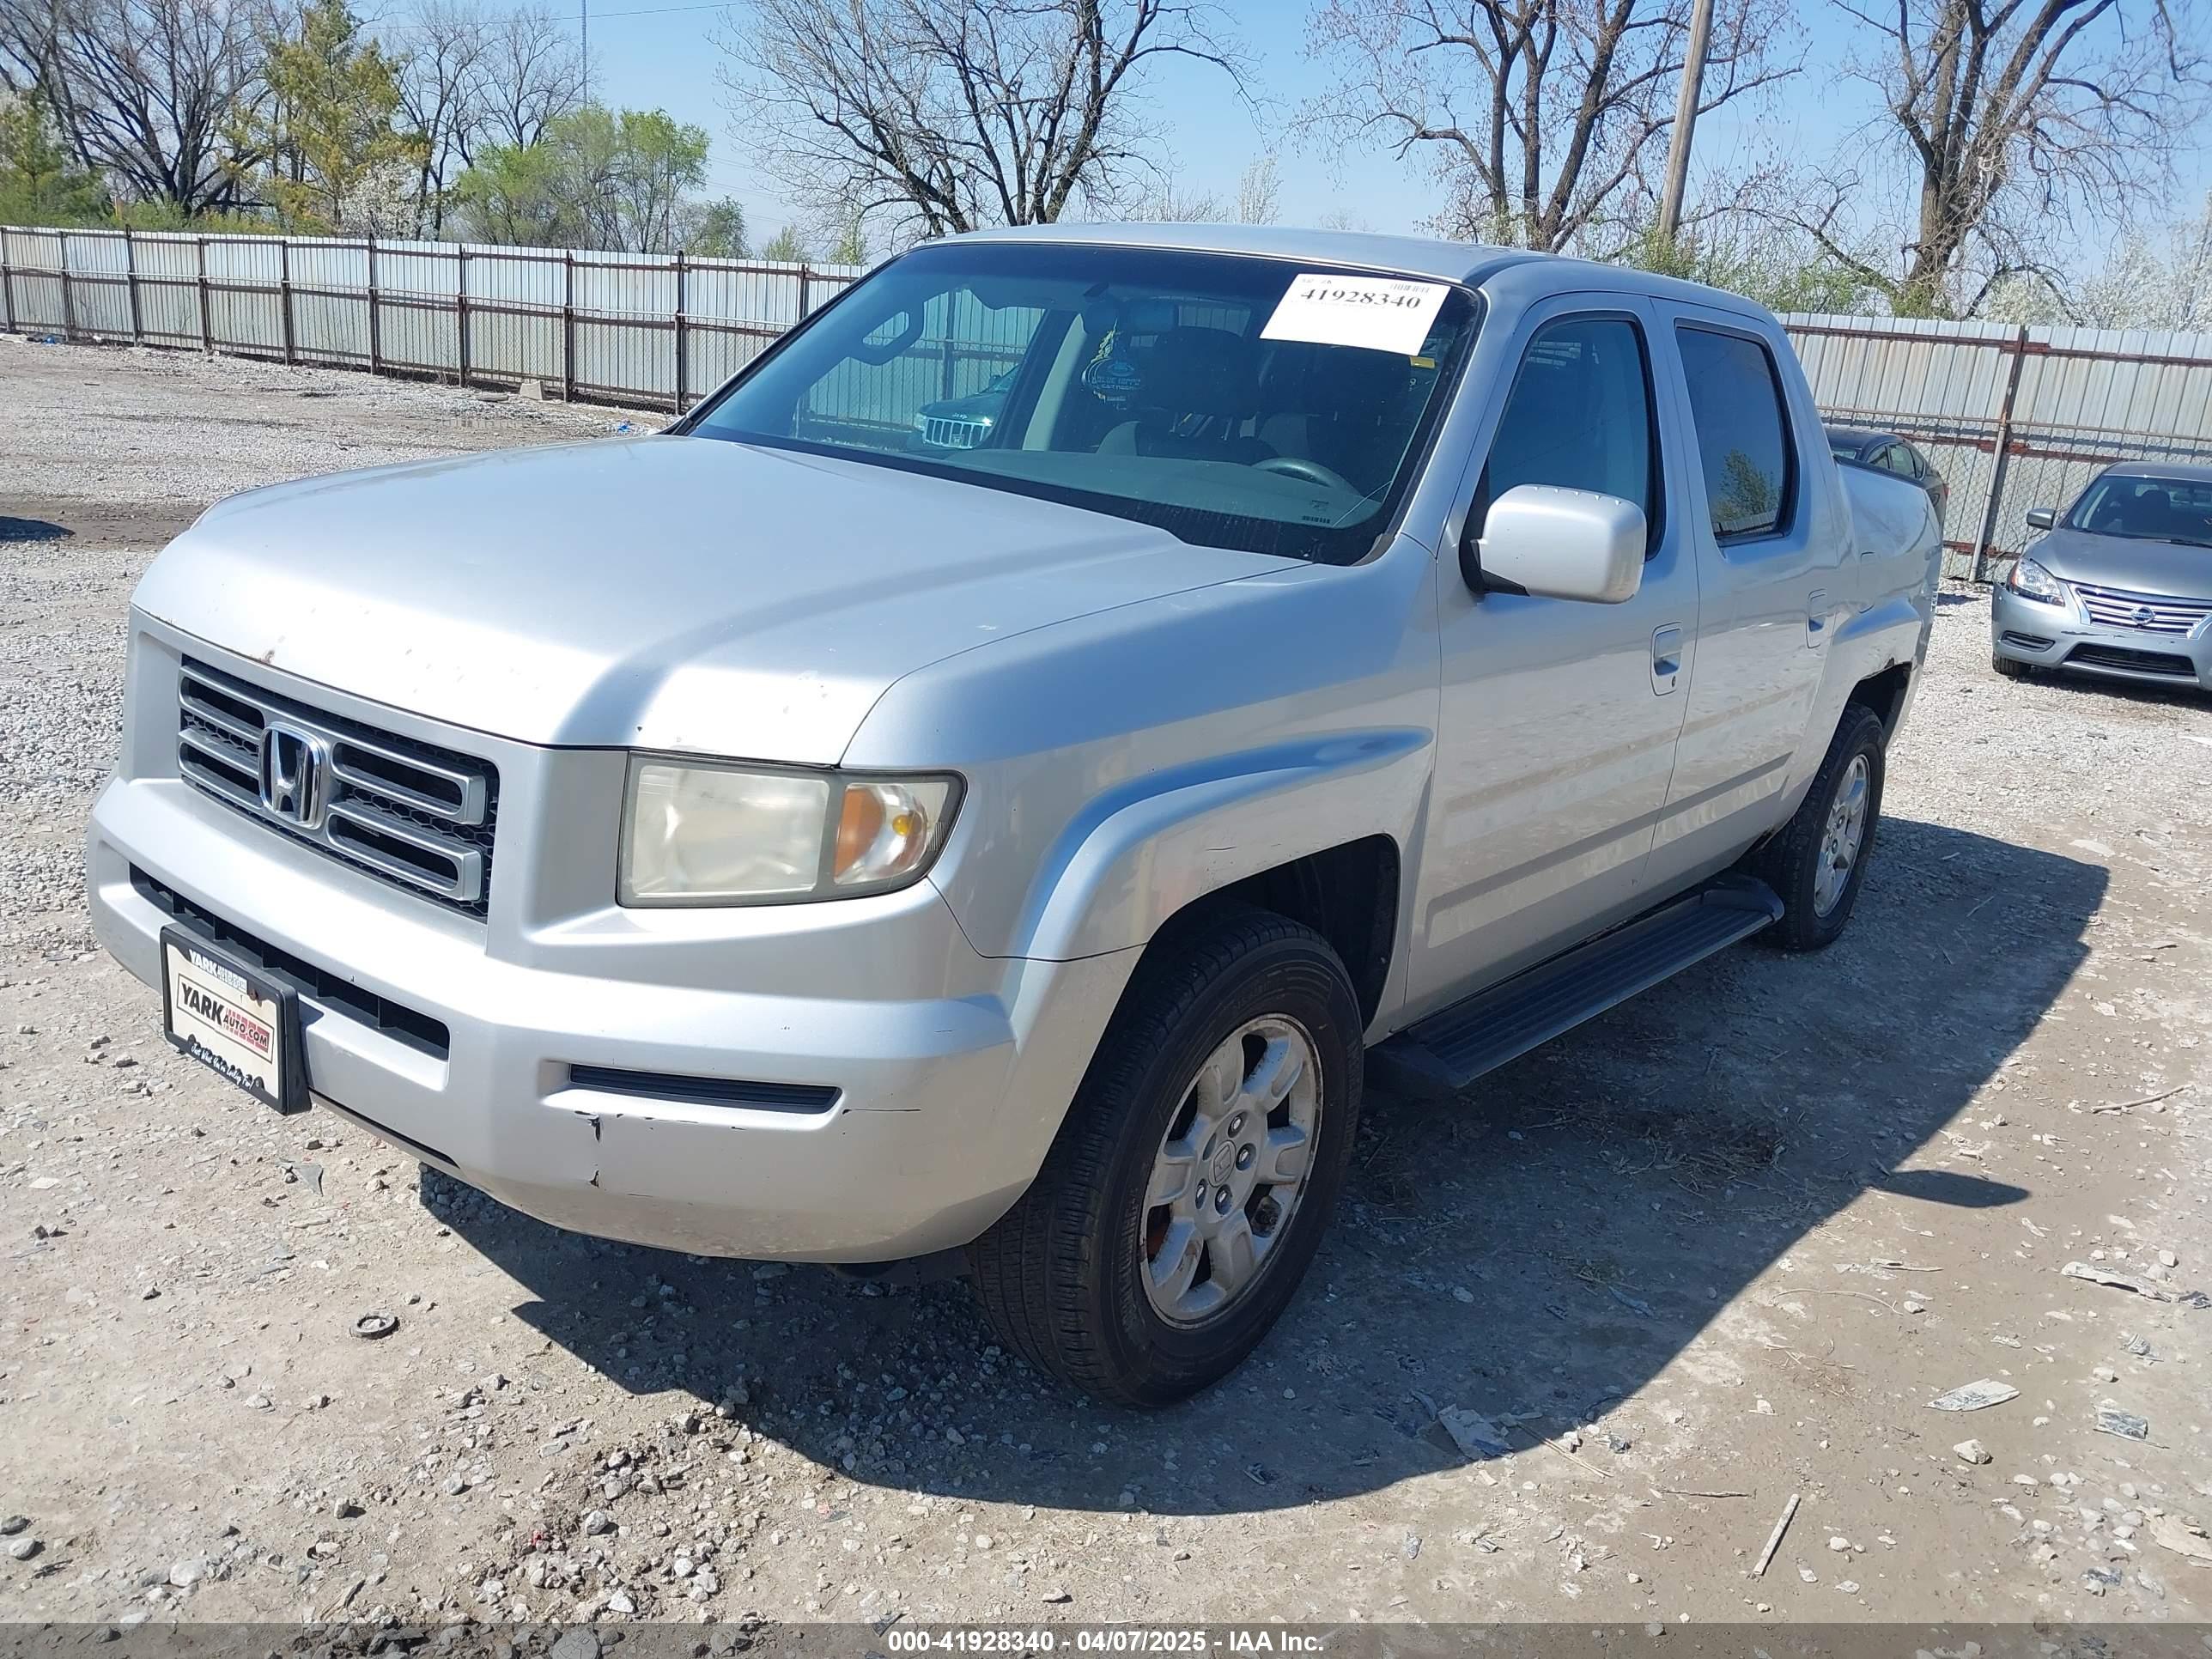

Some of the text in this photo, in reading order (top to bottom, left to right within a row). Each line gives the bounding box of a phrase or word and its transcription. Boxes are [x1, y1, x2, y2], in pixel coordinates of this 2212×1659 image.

[1300, 289, 1421, 309] 41928340
[189, 949, 217, 977] YARK
[181, 982, 268, 1047] YARK AUTO.COM
